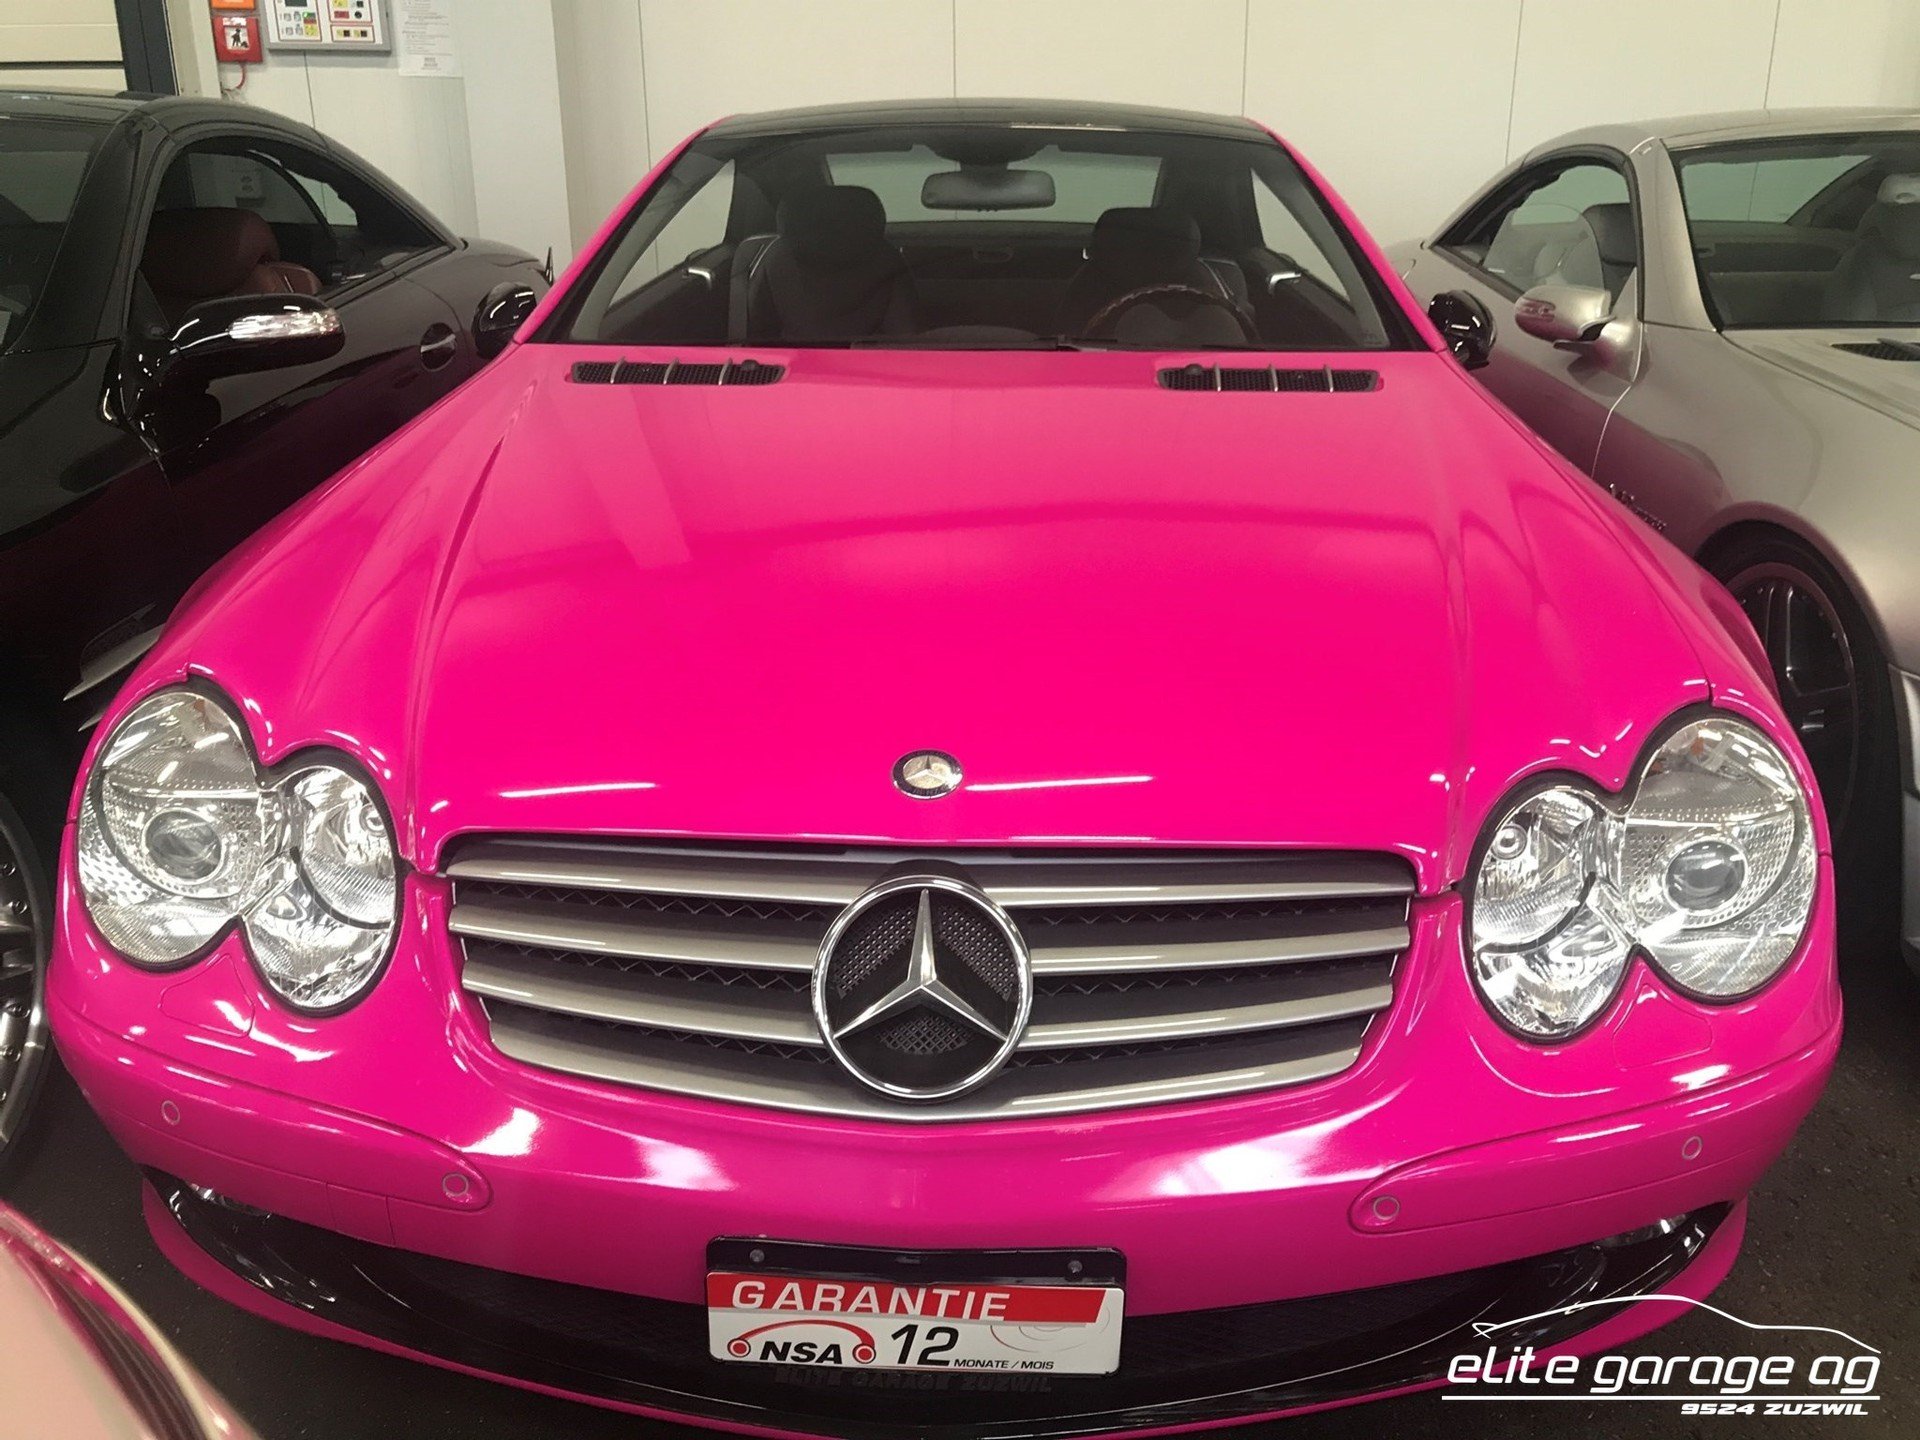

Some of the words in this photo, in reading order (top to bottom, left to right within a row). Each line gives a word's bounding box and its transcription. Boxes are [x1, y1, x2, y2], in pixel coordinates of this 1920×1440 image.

[732, 1280, 1011, 1322] GARANTIE
[760, 1341, 843, 1365] NSA
[890, 1324, 959, 1367] 12
[954, 1358, 1009, 1370] MONATE
[1020, 1361, 1055, 1371] MOIS
